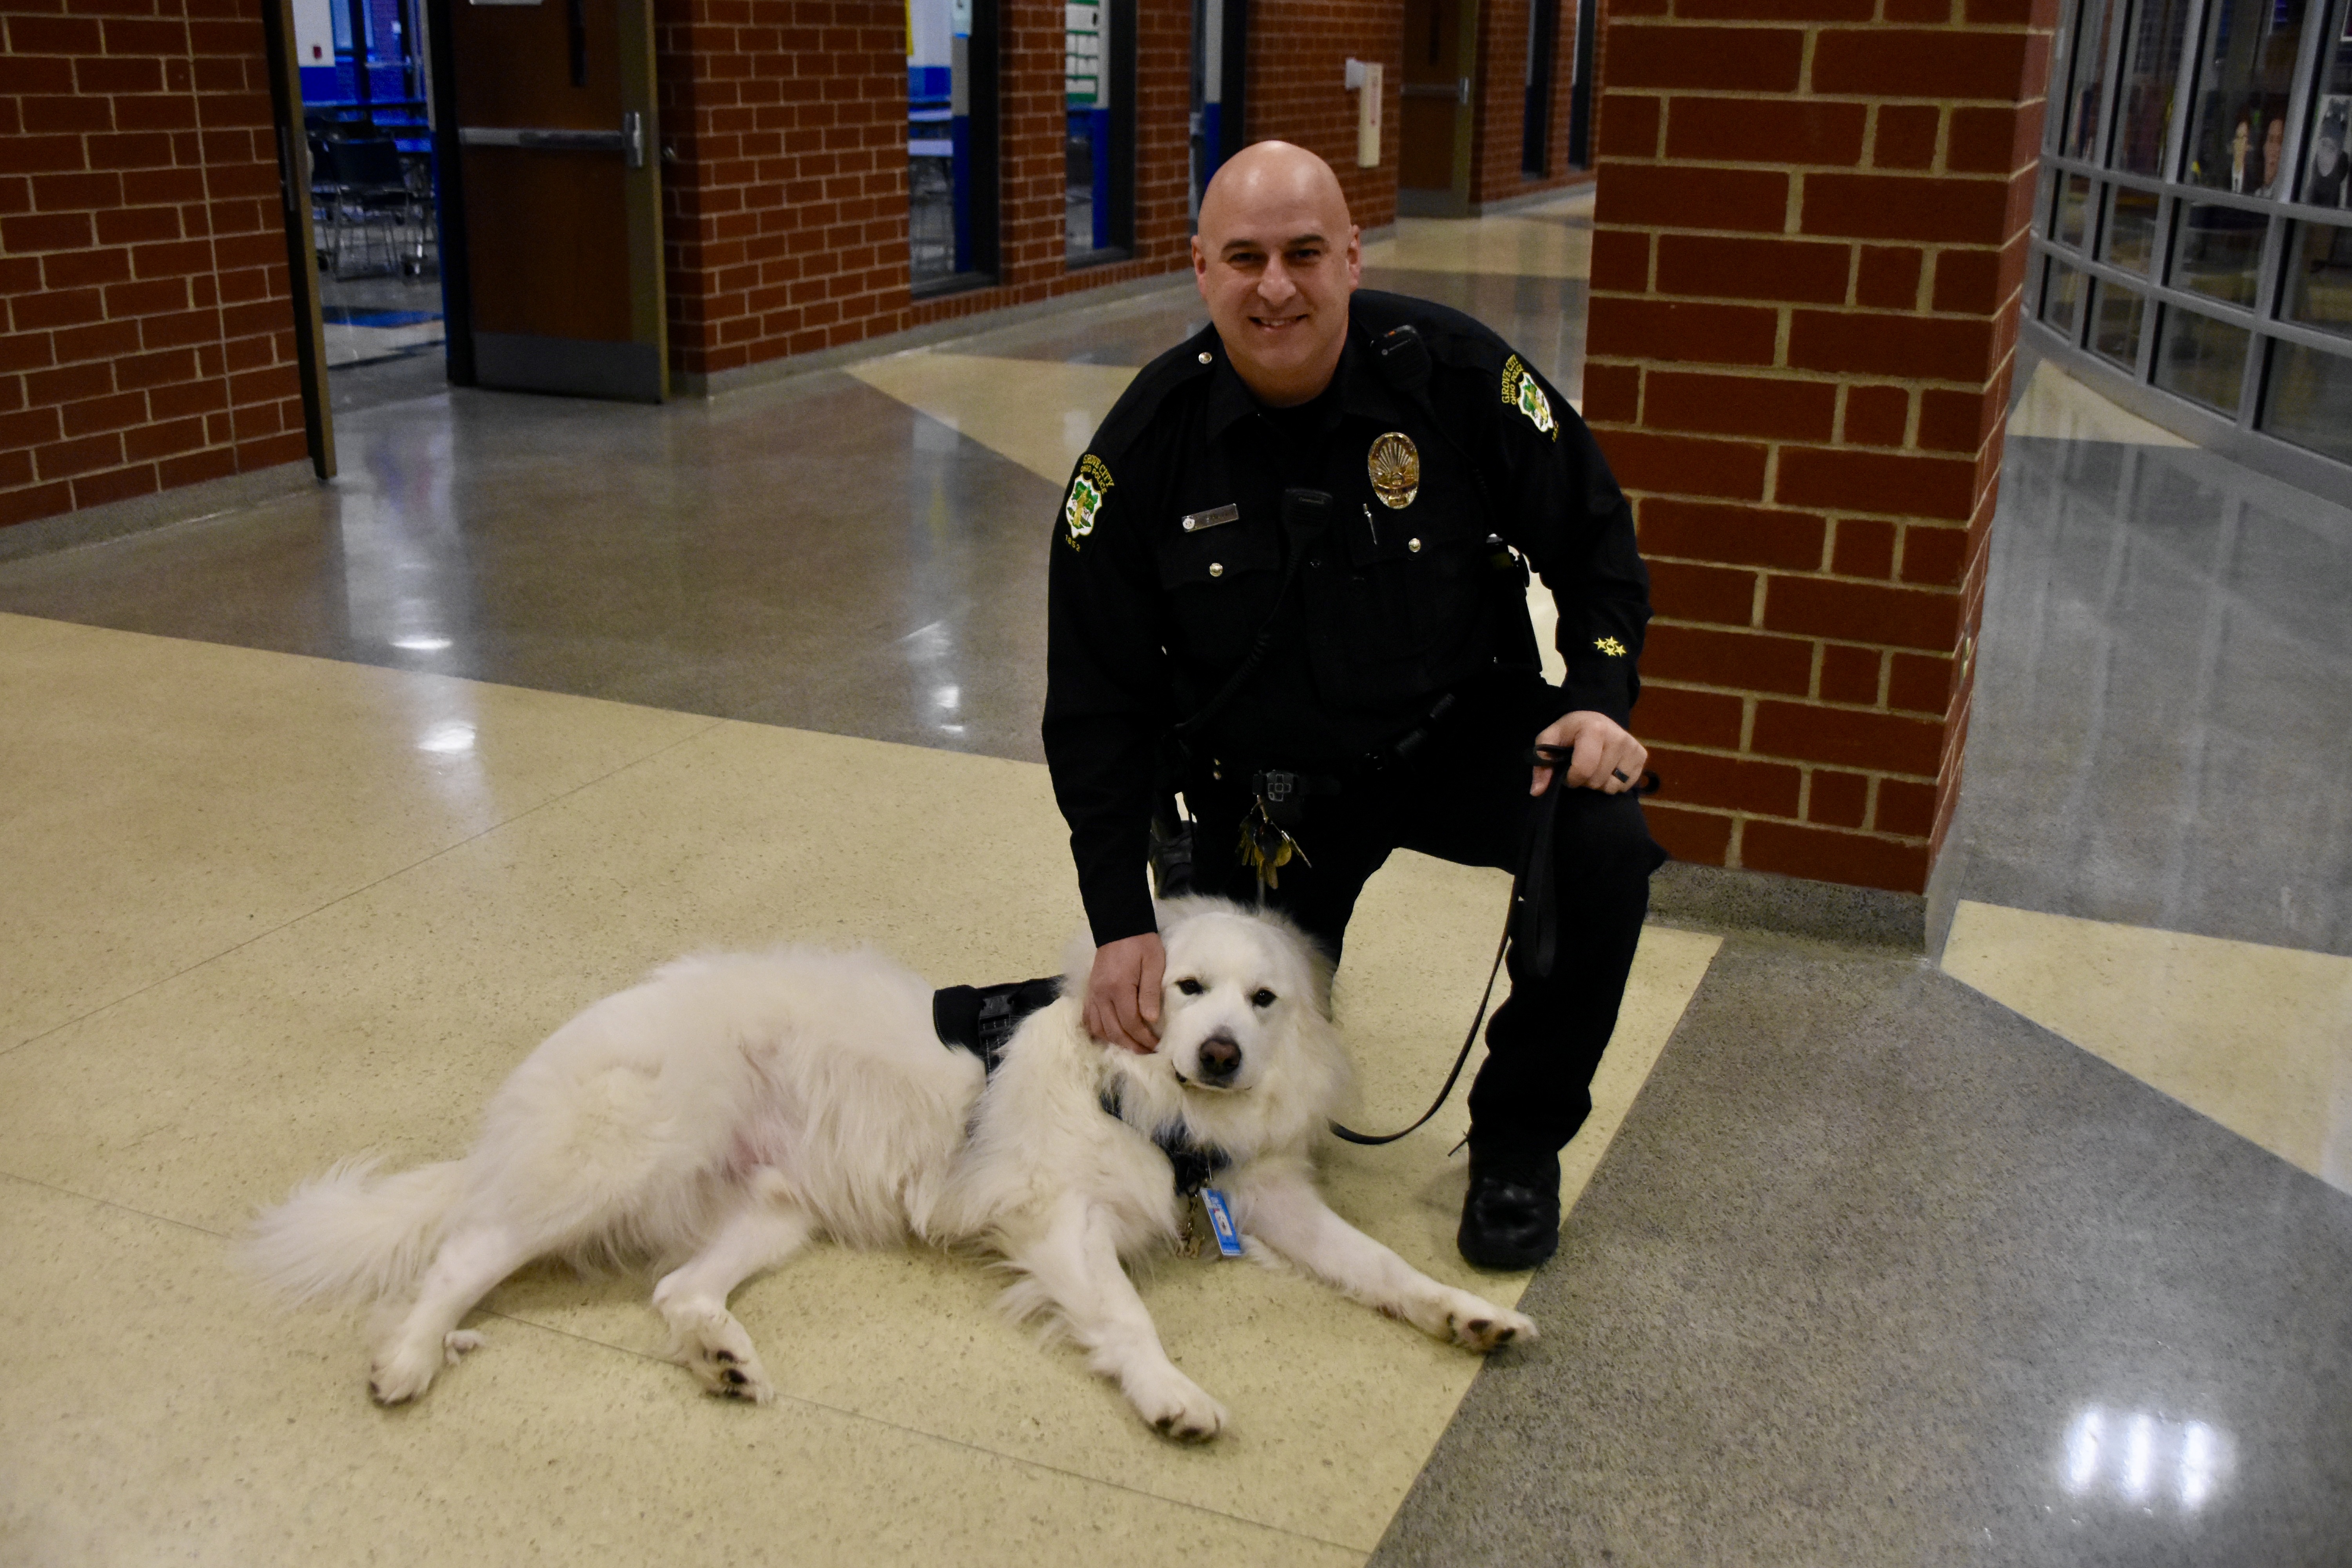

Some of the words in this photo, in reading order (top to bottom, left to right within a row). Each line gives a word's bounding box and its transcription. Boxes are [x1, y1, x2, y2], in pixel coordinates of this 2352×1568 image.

[1506, 354, 1518, 371] CITY
[1502, 368, 1511, 403] GROVE
[1083, 454, 1101, 468] GROVE
[1099, 465, 1114, 486] CITY
[1092, 468, 1107, 494] POLICE
[1065, 534, 1080, 552] 1852
